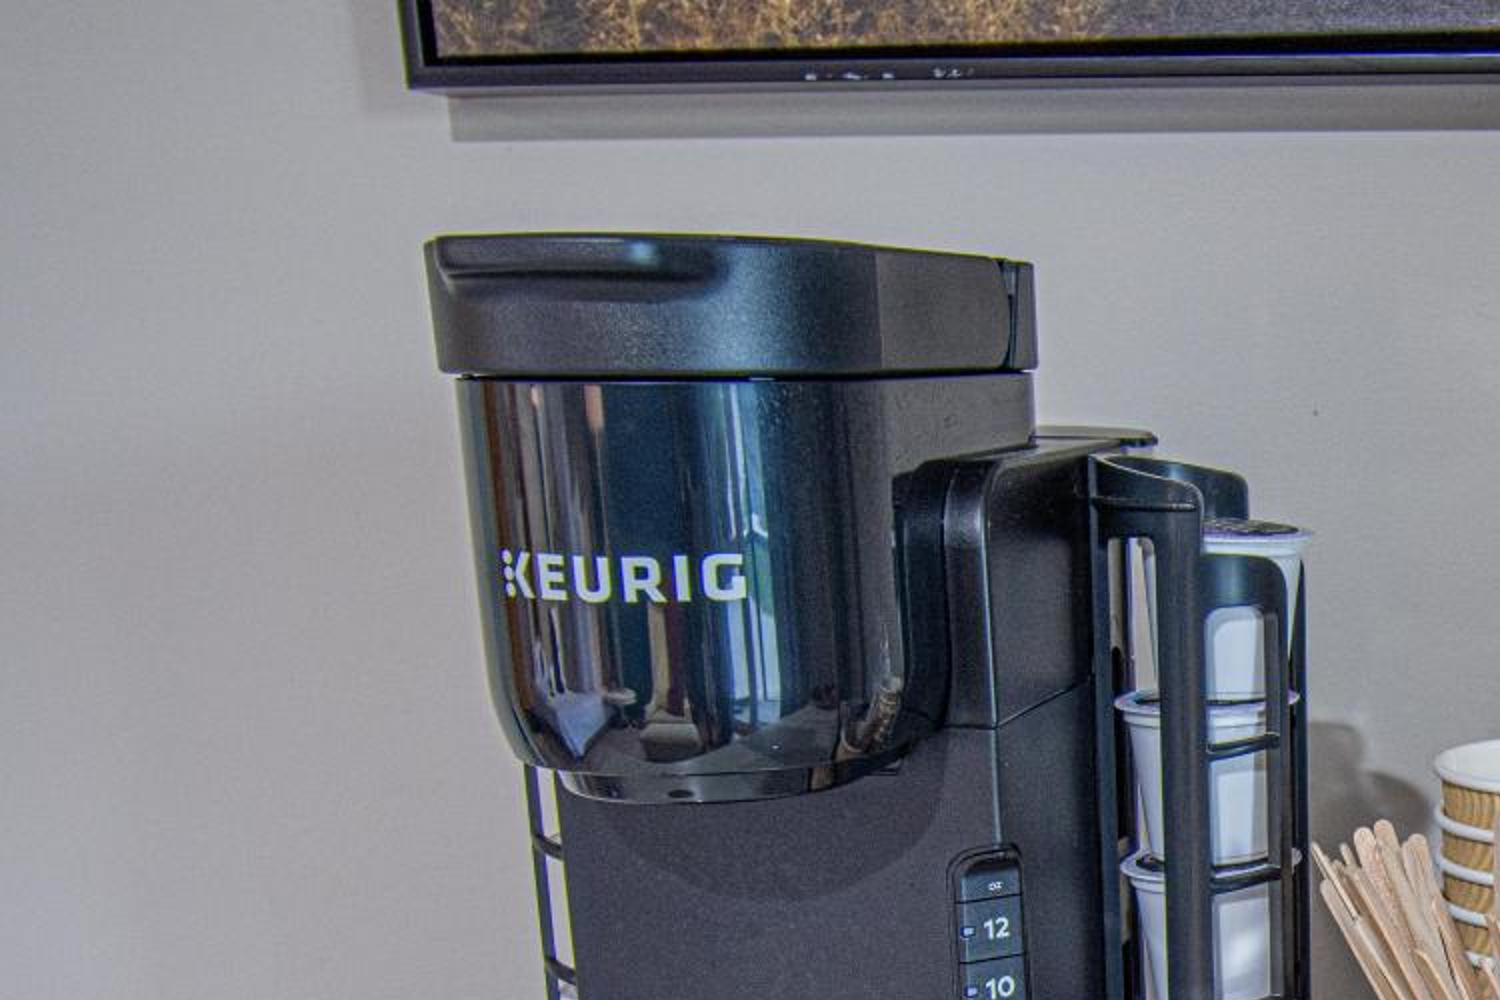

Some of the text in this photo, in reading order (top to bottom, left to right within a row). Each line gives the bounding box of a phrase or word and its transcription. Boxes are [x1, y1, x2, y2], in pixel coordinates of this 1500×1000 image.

[500, 548, 748, 604] KEURIG
[983, 917, 1011, 940] 12
[985, 975, 1016, 1000] 10
